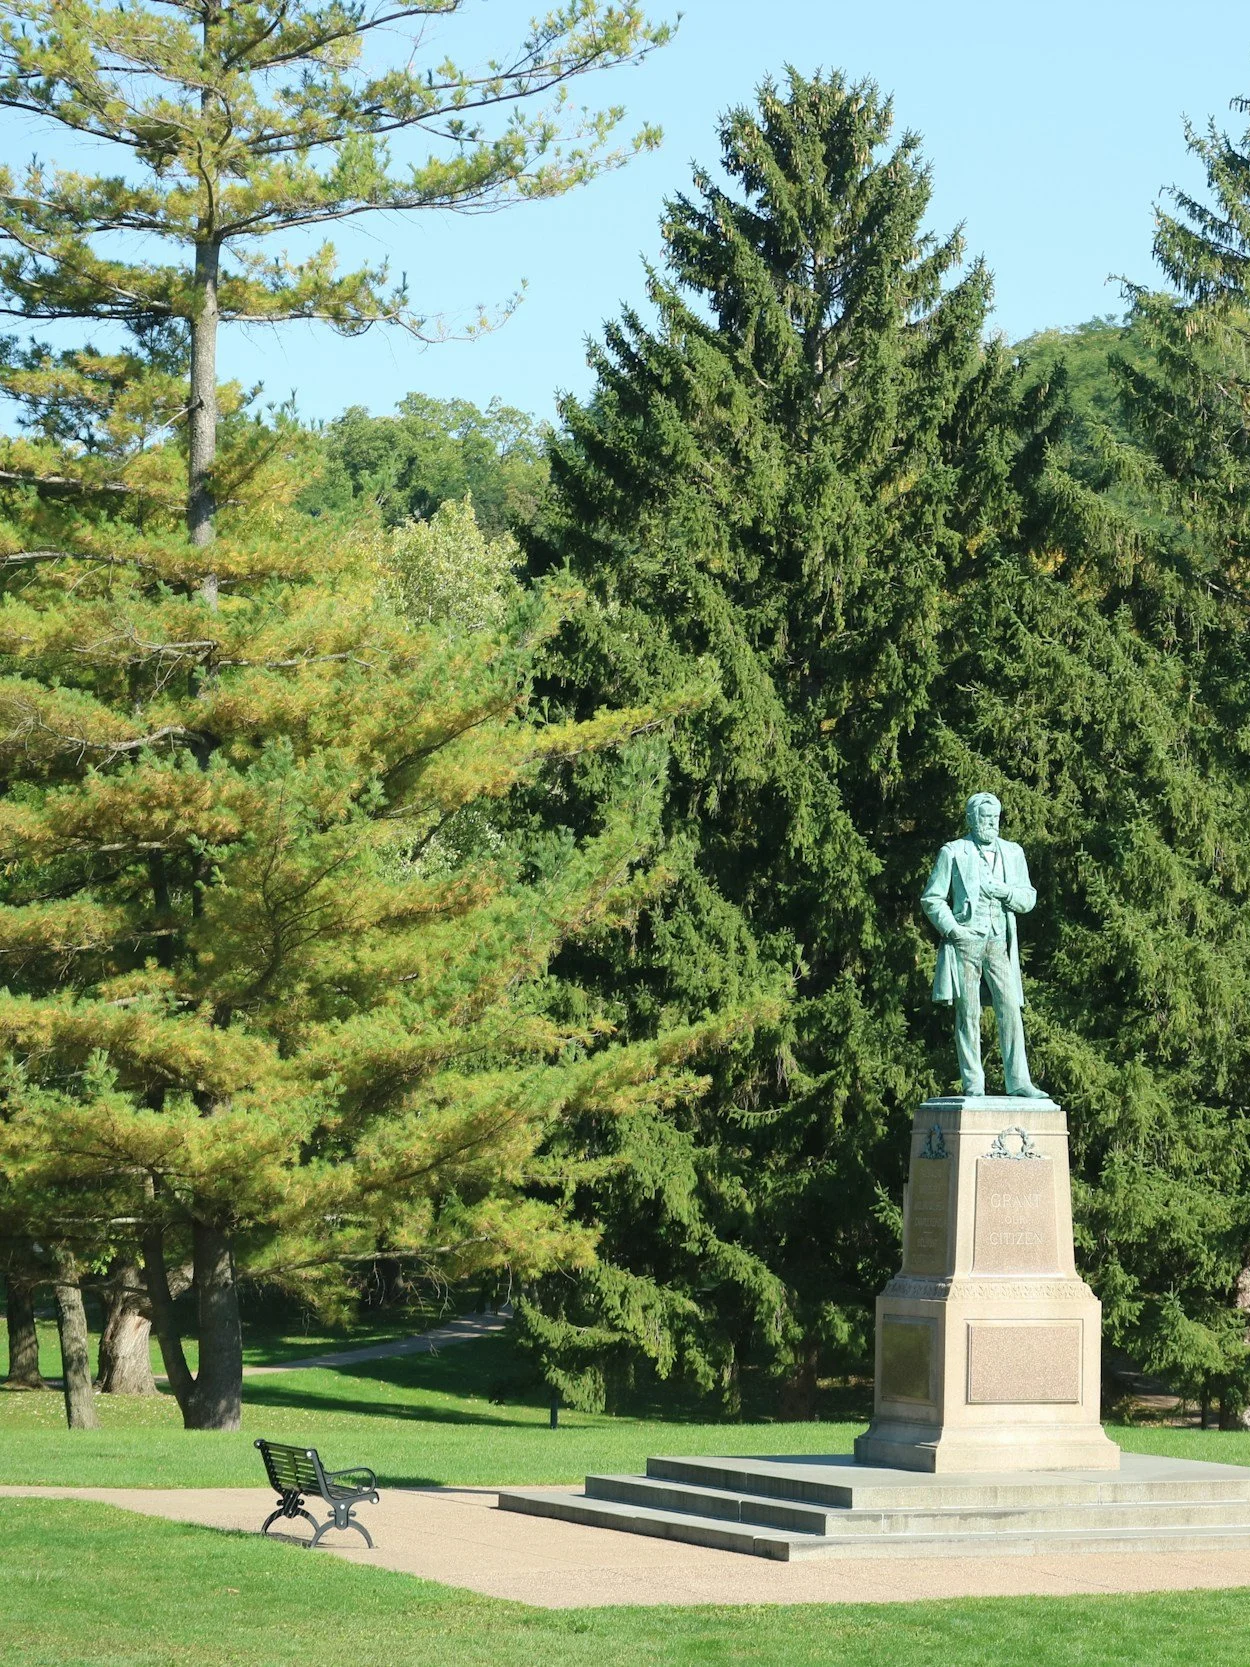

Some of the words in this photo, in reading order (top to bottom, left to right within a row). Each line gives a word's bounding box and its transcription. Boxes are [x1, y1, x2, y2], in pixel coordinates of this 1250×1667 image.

[990, 1193, 1041, 1208] GRANT
[1004, 1215, 1028, 1225] OUR
[989, 1232, 1043, 1245] CITIZEN
